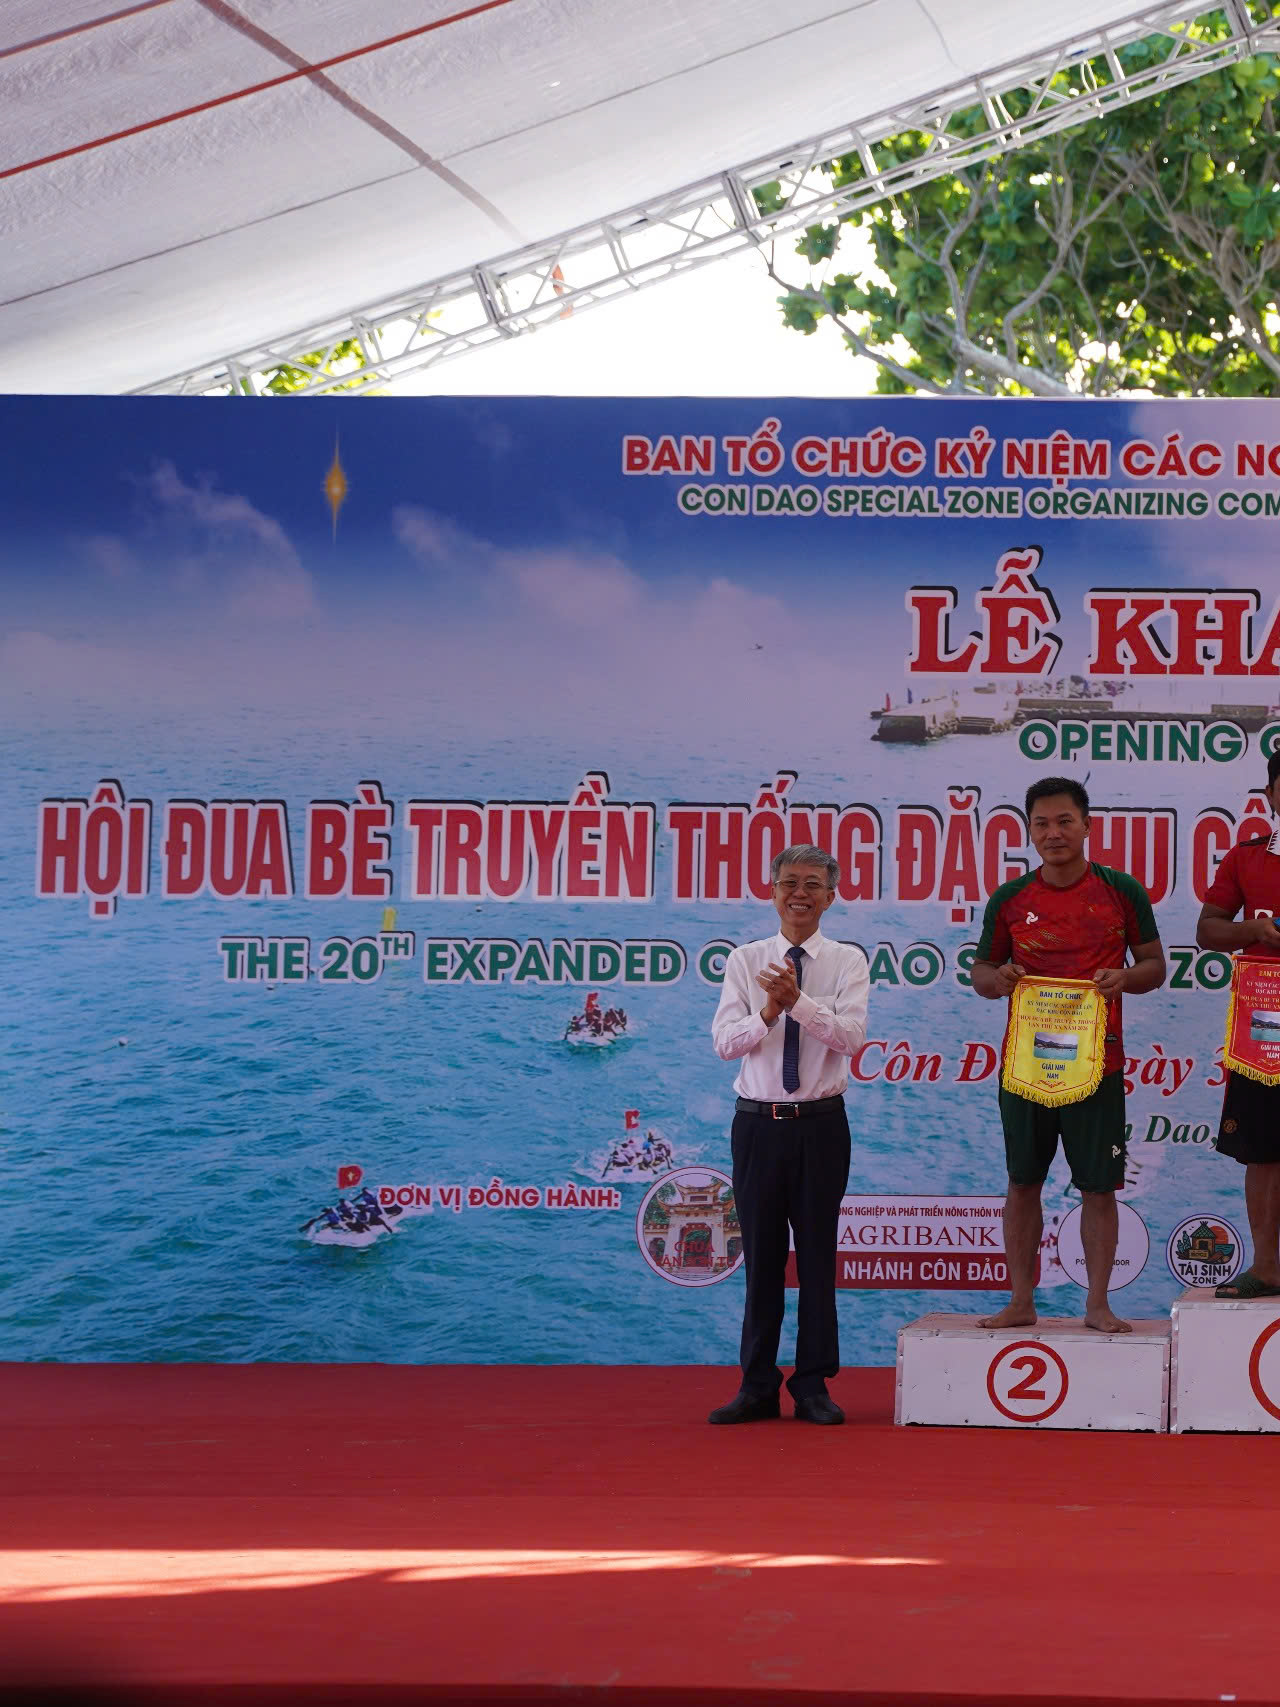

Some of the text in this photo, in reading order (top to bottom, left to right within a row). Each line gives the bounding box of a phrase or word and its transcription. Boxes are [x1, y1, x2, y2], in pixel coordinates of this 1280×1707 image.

[626, 440, 713, 473] BAN
[727, 419, 781, 474] TỔ
[795, 432, 922, 475] CHỨC
[937, 426, 992, 476] KỶ
[1006, 433, 1107, 486] NIỆM
[1123, 434, 1221, 477] CÁC
[680, 488, 748, 512] CON
[757, 488, 818, 512] DAO
[827, 489, 943, 514] SPECIAL
[948, 491, 1019, 514] ZONE
[1029, 490, 1208, 516] ORGANIZING
[910, 556, 1055, 674] LỄ
[1019, 723, 1243, 762] OPENING
[41, 786, 144, 915] HỘI
[165, 807, 291, 897] ĐUA
[309, 788, 391, 897] BÈ
[409, 779, 651, 898] TRUYỀN
[896, 794, 1022, 923] ĐẶC
[1088, 815, 1169, 905] HU
[221, 942, 305, 980] THE
[427, 942, 681, 983] EXPANDED
[868, 945, 940, 986] AO
[1169, 951, 1234, 989] ZO
[850, 1040, 942, 1082] Côn
[1124, 1044, 1194, 1097] gày
[1143, 1115, 1218, 1150] Dao,
[379, 1177, 620, 1213] ĐƠN VỊ ĐỒNG HÀNH:
[855, 1205, 885, 1218] NGHIỆP
[898, 1206, 919, 1217] PHÁT
[920, 1204, 944, 1218] TRIỂN
[945, 1206, 968, 1218] NÔNG
[969, 1206, 992, 1218] THÔN
[838, 1225, 1000, 1247] AGRIBANK
[843, 1257, 1007, 1282] NHÁNH CÔN ĐẢO
[1178, 1261, 1232, 1277] TÁI SINH
[1192, 1276, 1218, 1285] ZONE
[1005, 1354, 1049, 1402] 2
